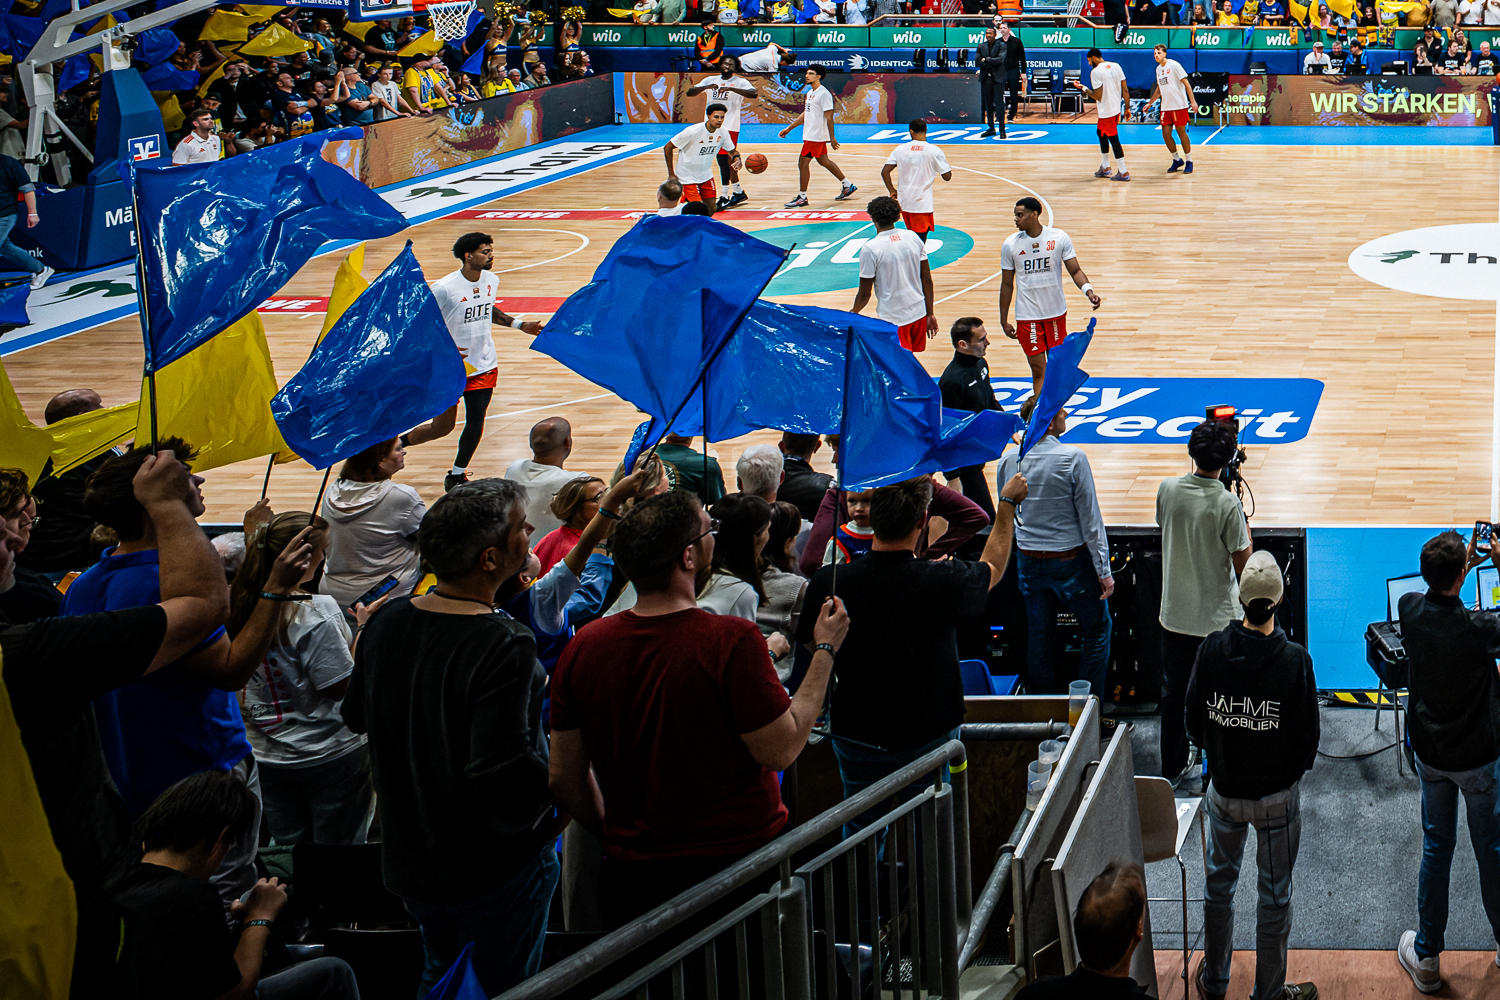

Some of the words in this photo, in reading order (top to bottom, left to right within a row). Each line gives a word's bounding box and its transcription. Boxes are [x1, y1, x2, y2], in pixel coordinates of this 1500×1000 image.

[593, 30, 621, 43] wilo
[668, 30, 696, 43] wilo
[743, 31, 771, 43] wilo
[817, 31, 846, 43] wilo
[893, 31, 921, 44] wilo
[1043, 31, 1071, 44] wilo
[1194, 33, 1220, 45] wilo
[1311, 93, 1357, 113] WIR
[1364, 88, 1482, 118] STÄRKEN,
[700, 145, 716, 154] BITE
[447, 142, 627, 186] Thalia
[475, 212, 571, 220] REWE
[767, 211, 858, 219] REWE
[1046, 240, 1055, 251] 30
[1024, 257, 1050, 270] BITE
[487, 285, 492, 296] 2
[262, 299, 322, 310] WE
[465, 303, 491, 319] BITE
[1209, 710, 1279, 731] IMMOBILIEN
